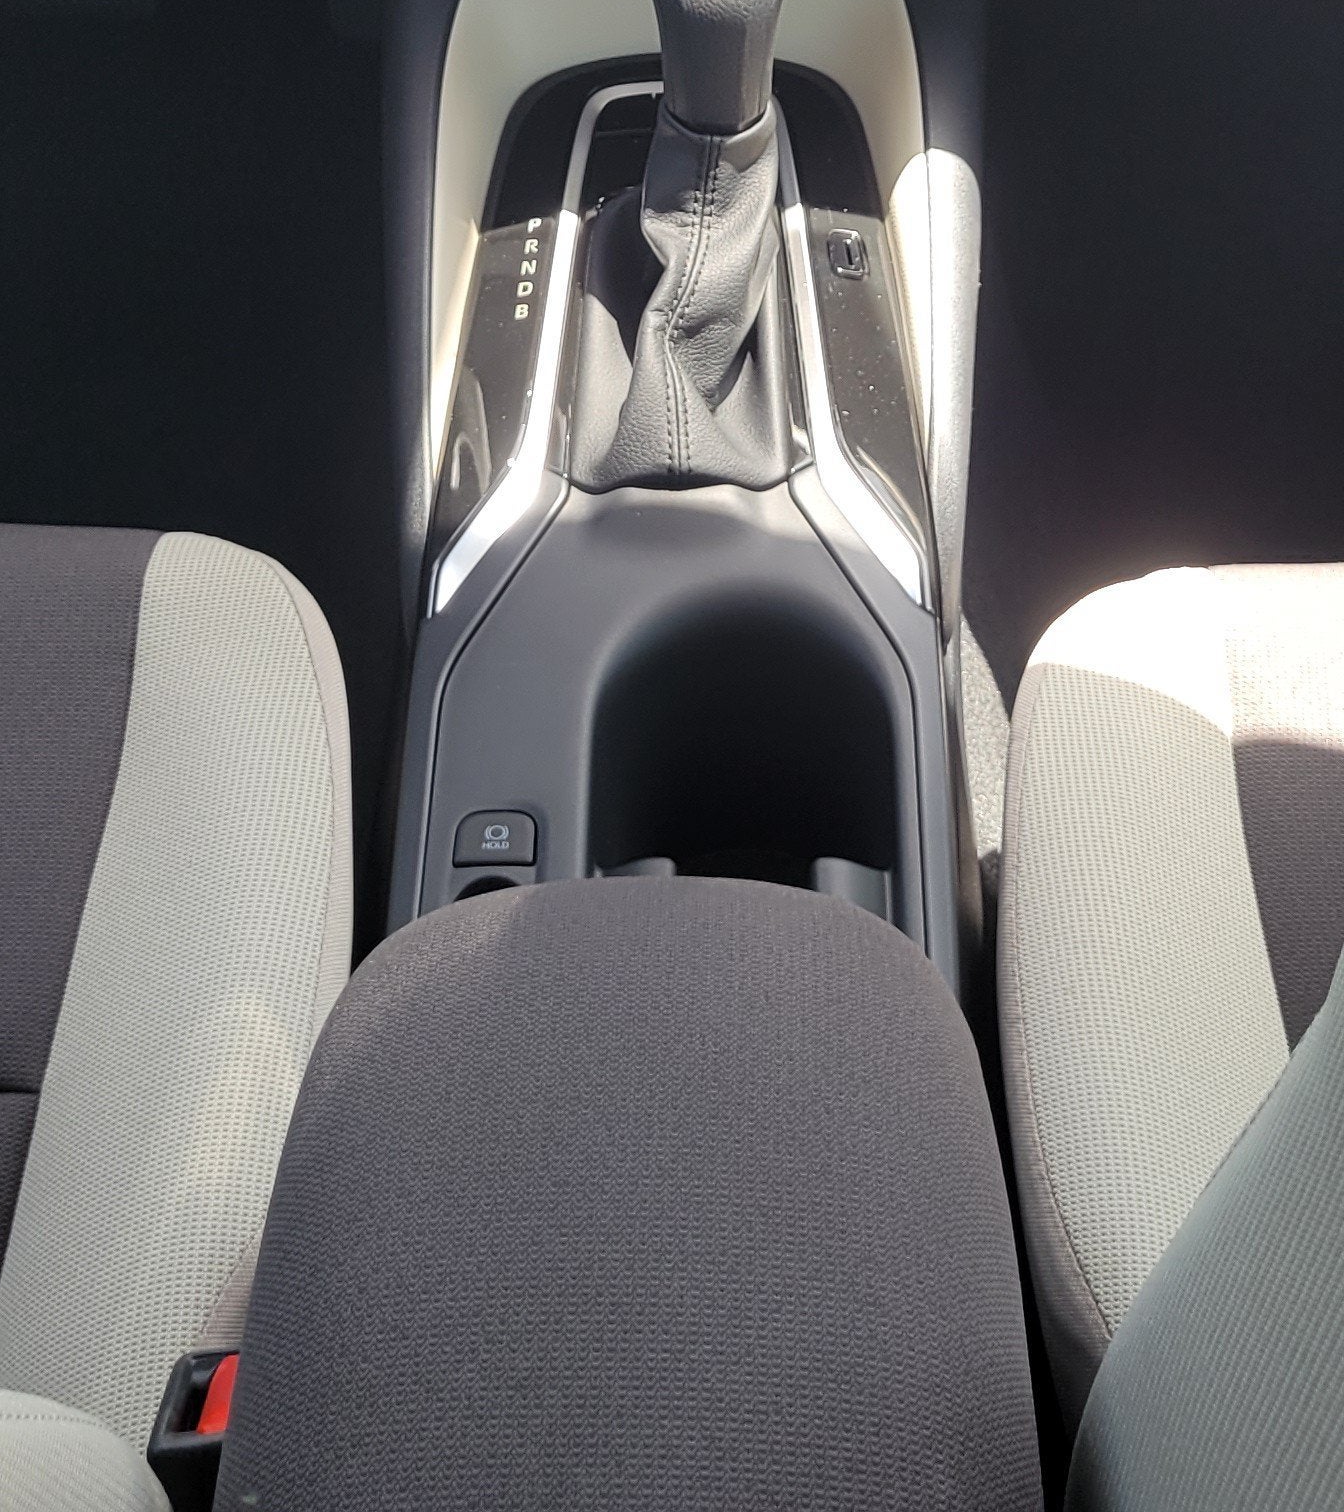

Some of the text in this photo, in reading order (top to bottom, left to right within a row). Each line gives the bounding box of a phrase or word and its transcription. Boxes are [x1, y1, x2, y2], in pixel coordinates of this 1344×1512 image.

[514, 217, 542, 320] P R N D B
[482, 841, 509, 850] HOLD
